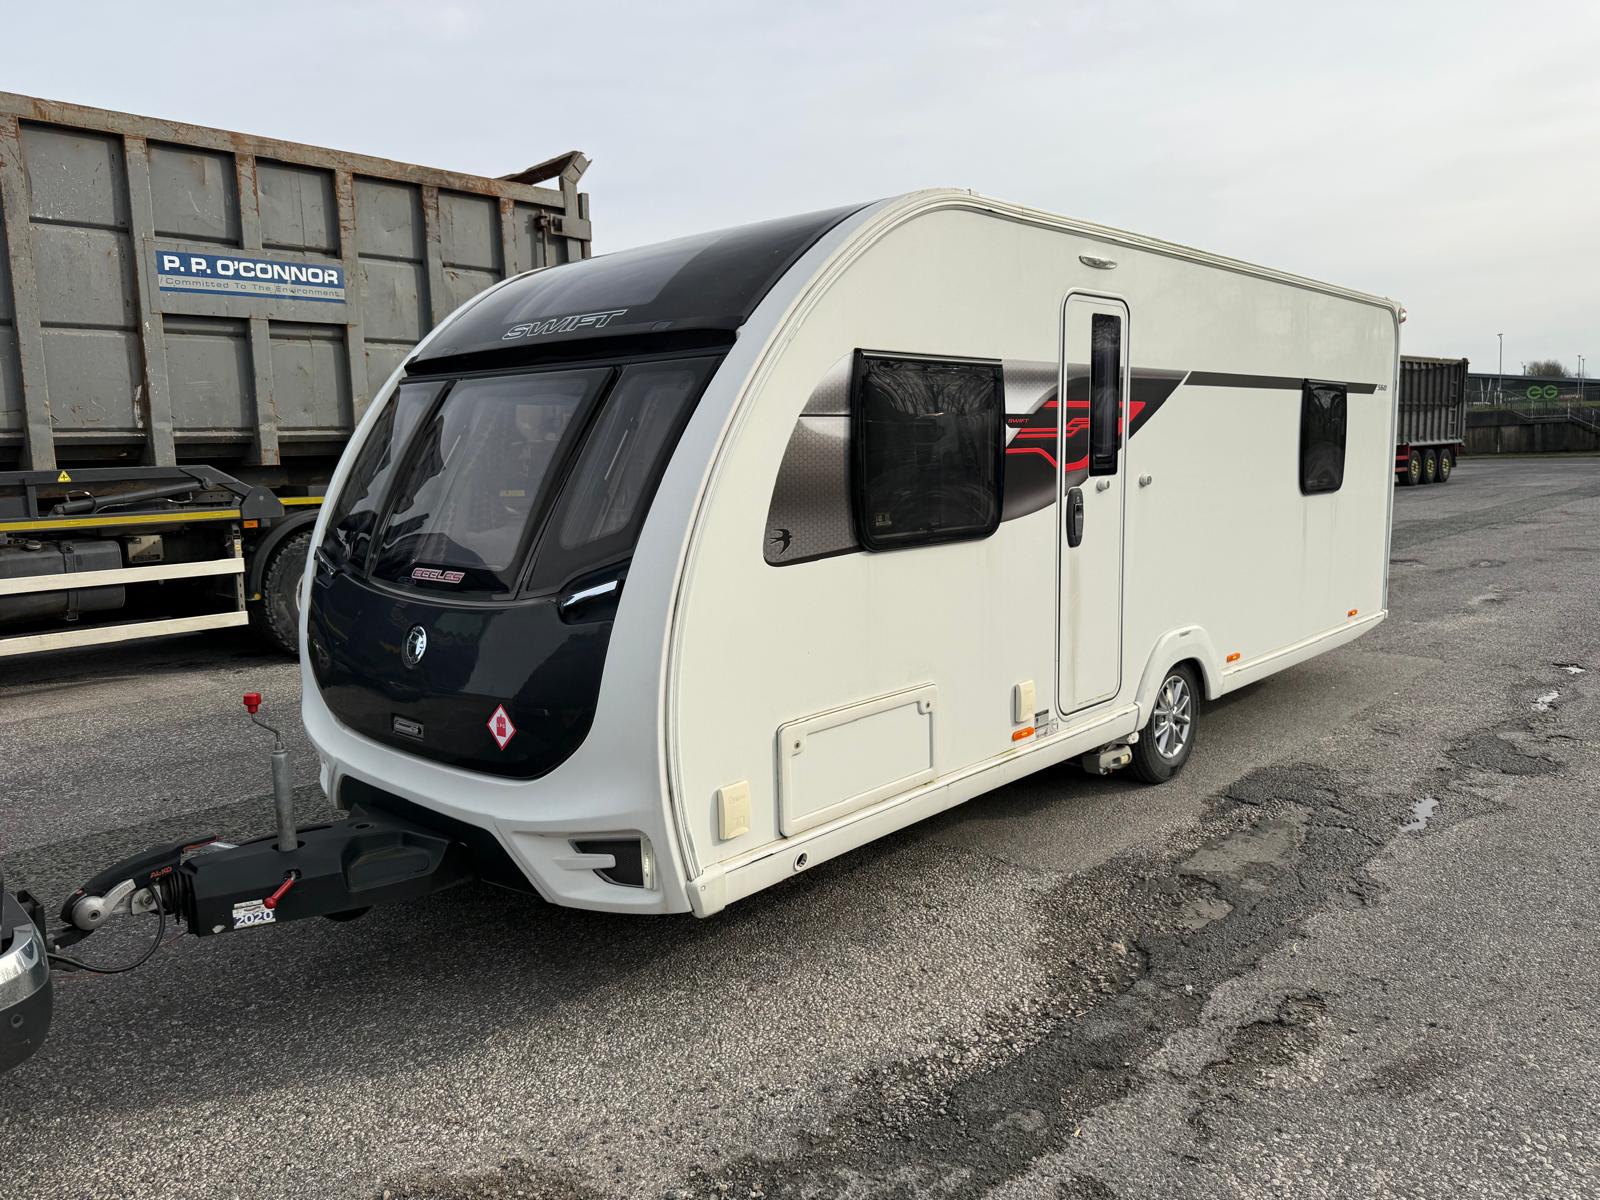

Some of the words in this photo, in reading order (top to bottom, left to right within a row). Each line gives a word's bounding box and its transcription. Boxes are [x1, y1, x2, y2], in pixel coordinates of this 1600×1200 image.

[163, 255, 185, 272] P.
[190, 257, 212, 274] P.
[216, 259, 339, 284] O'CONNOR
[165, 277, 229, 289] Committed
[234, 282, 247, 290] To
[253, 283, 271, 292] The
[275, 285, 340, 298] Environment
[502, 308, 628, 340] SWIFT
[235, 910, 274, 927] 2020
